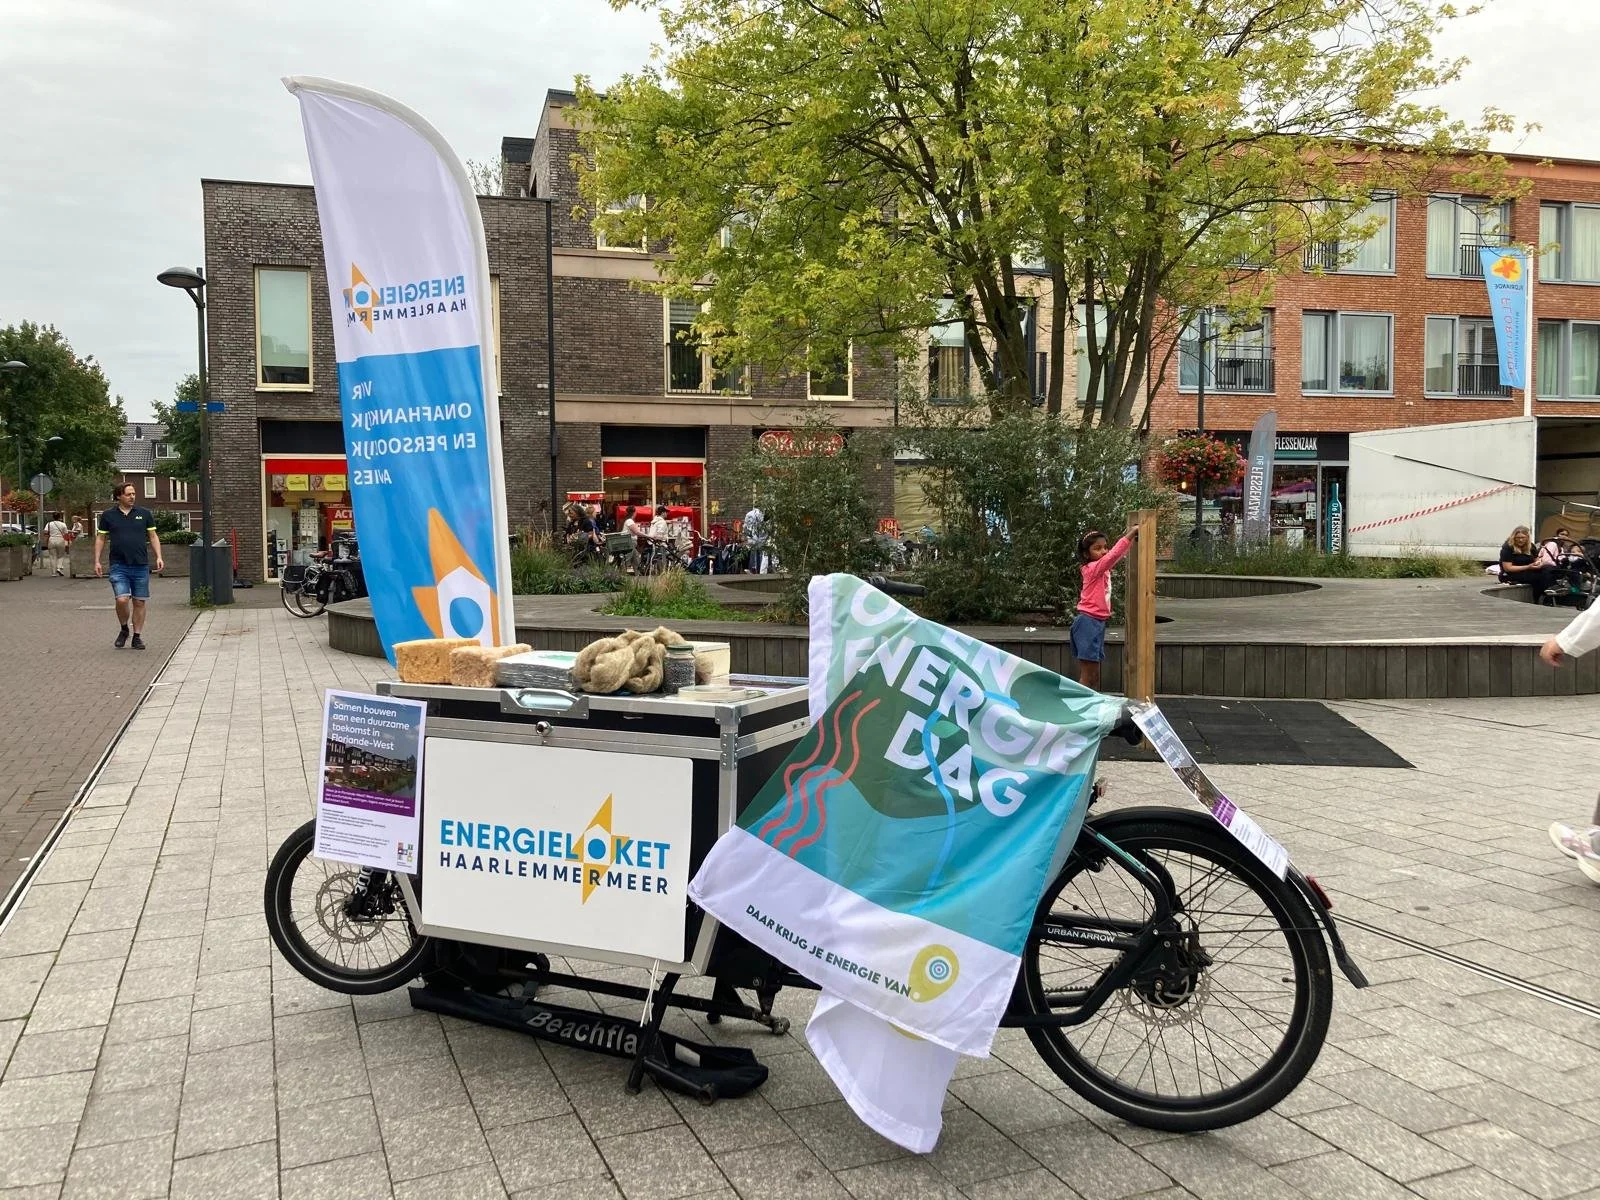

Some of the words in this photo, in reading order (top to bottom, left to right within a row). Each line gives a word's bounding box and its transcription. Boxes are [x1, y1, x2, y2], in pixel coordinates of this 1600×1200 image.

[1274, 437, 1318, 451] FLESSENZAAK
[333, 702, 361, 713] Samen
[363, 705, 397, 717] bouwen
[332, 713, 349, 721] aan
[350, 716, 366, 724] een
[367, 717, 410, 731] duurzame
[332, 723, 371, 736] toekomst
[372, 728, 380, 737] in
[331, 733, 395, 751] Floriande-West
[884, 710, 1030, 818] DAG
[440, 819, 671, 870] ENERGIELOKET
[440, 851, 669, 895] HAARLEMMERMEER
[1047, 927, 1079, 938] URBAN
[1080, 932, 1116, 943] ARROW
[746, 904, 775, 930] DAAR
[775, 923, 808, 950] KRIJG
[809, 946, 824, 959] JE
[825, 952, 882, 985] ENERGIE
[884, 976, 912, 998] VAN
[526, 1012, 638, 1055] Beachfla
